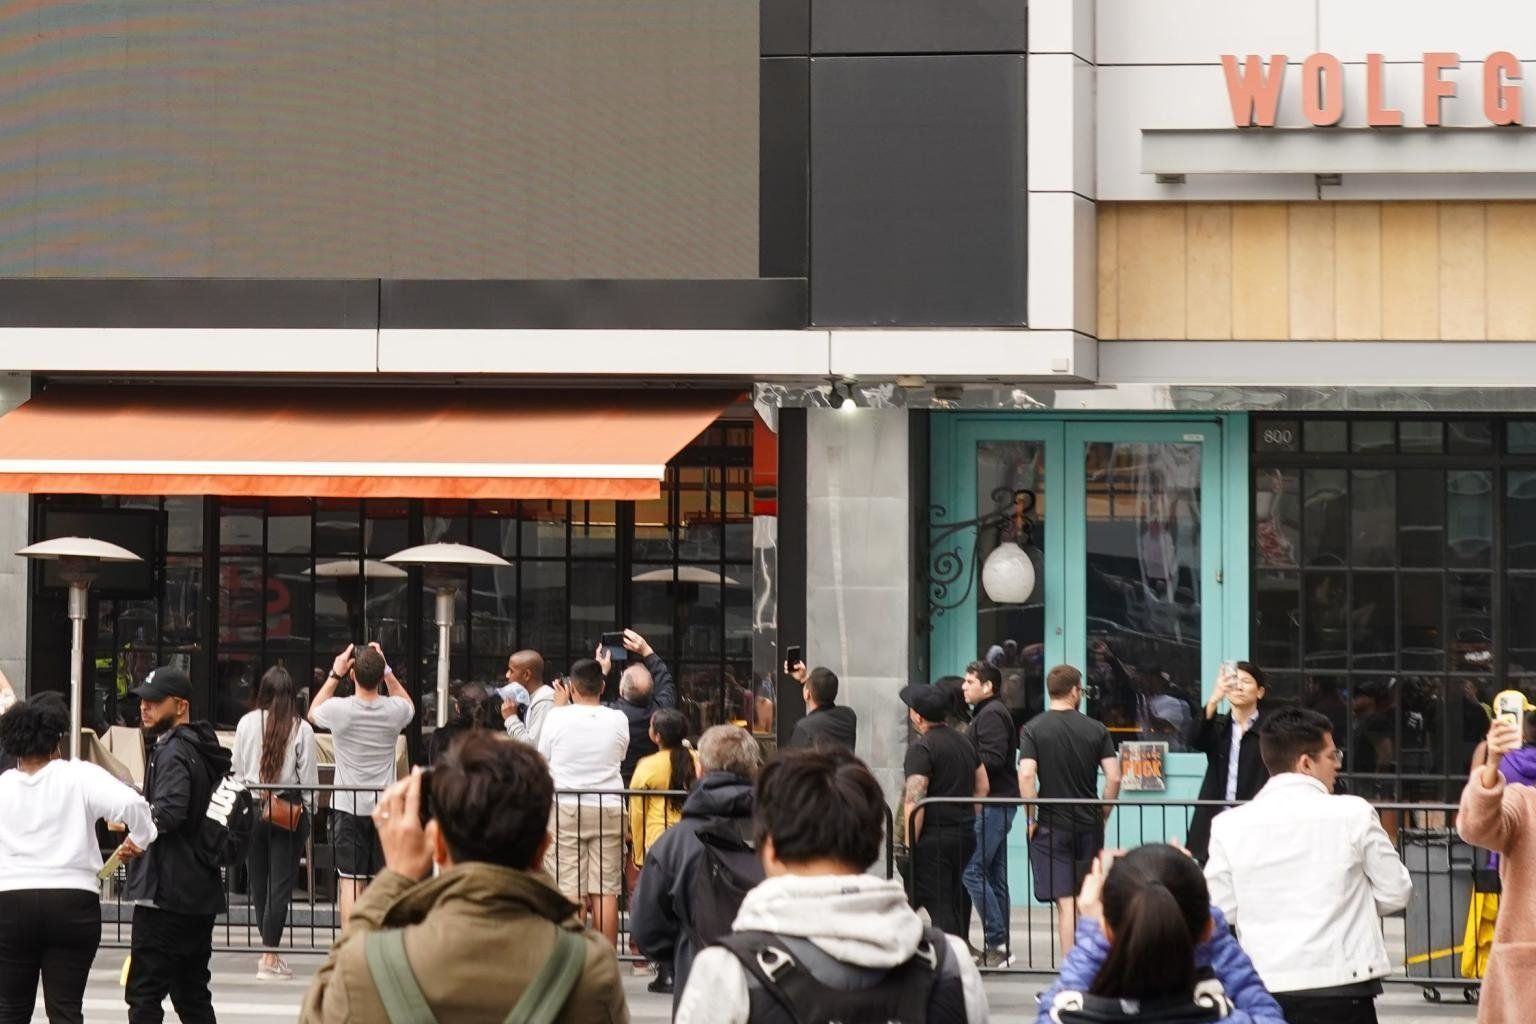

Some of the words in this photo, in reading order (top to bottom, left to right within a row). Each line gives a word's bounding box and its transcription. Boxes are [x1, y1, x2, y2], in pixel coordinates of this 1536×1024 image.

[1221, 51, 1522, 128] WOLFG
[1264, 429, 1292, 444] 800
[1122, 759, 1162, 777] PUCK
